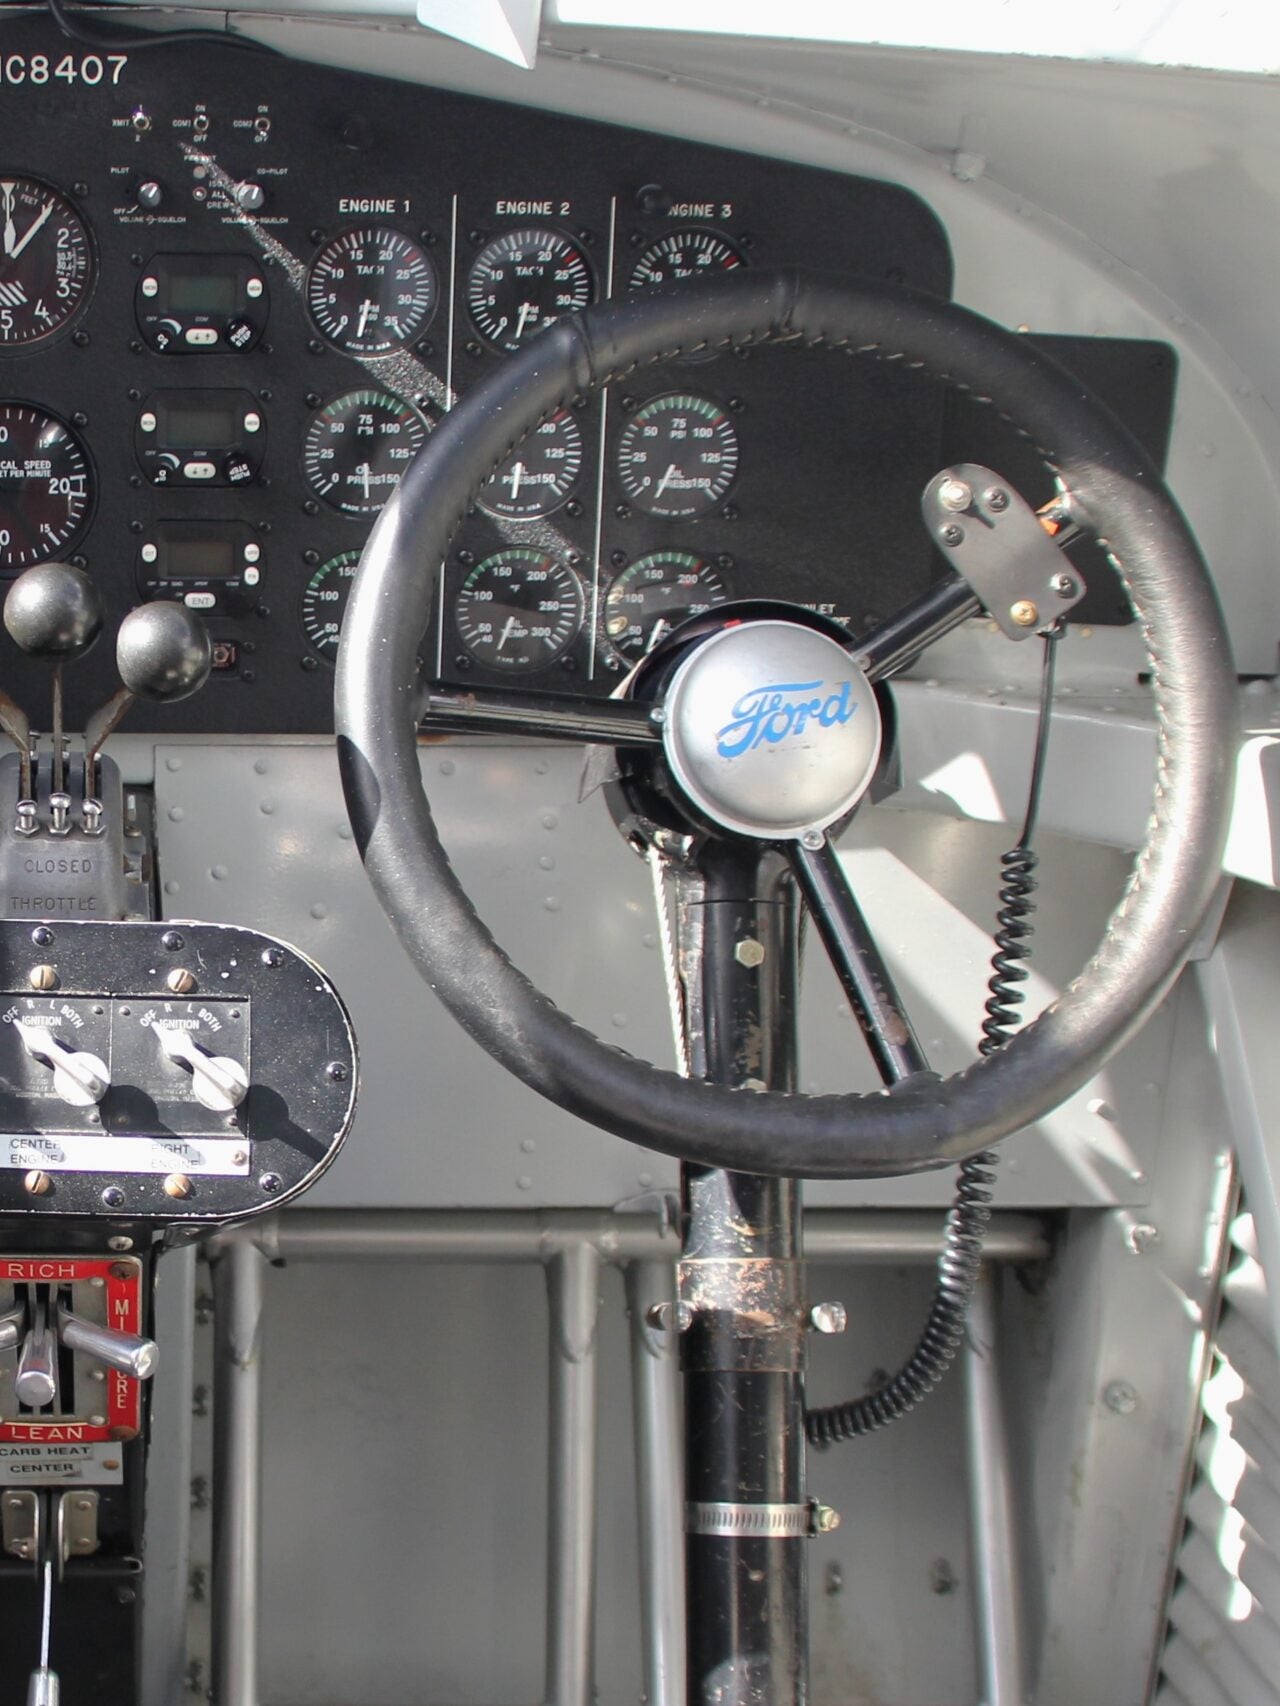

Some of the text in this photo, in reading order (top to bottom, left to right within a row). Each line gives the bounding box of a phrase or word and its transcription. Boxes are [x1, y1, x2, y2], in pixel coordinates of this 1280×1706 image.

[194, 105, 206, 113] ON
[257, 105, 269, 113] ON
[193, 134, 209, 143] OFF
[110, 167, 130, 175] PILOT
[338, 200, 410, 214] ENGINE 1
[495, 201, 570, 216] ENGINE 2
[668, 203, 733, 219] NGINE 3
[56, 227, 70, 249] 2
[56, 278, 71, 298] 3
[34, 298, 50, 319] 4
[0, 309, 14, 330] 5
[380, 423, 401, 434] 100
[670, 429, 687, 440] PSI
[692, 427, 714, 439] 100
[389, 449, 410, 460] 125
[545, 448, 566, 460] 125
[699, 453, 721, 463] 125
[23, 459, 52, 471] SPEED
[9, 469, 25, 478] PER
[26, 469, 52, 478] MINUTE
[48, 477, 70, 495] 20
[492, 566, 513, 578] 150
[527, 570, 548, 582] 200
[643, 569, 664, 580] 150
[677, 573, 699, 584] 200
[192, 597, 210, 605] ENT
[319, 590, 339, 602] 100
[473, 590, 494, 602] 100
[624, 593, 645, 604] 100
[539, 600, 560, 612] 250
[530, 627, 552, 638] 300
[716, 680, 860, 759] Ford
[23, 859, 93, 874] CLOSED
[10, 897, 98, 911] THROTTLE
[2, 999, 85, 1030] OFF R L BOTH
[139, 1002, 223, 1033] OFF R L BOTH
[21, 1015, 62, 1027] IGNITION
[159, 1018, 201, 1030] IGNITION
[7, 1263, 76, 1278] RICH
[11, 1426, 84, 1440] LEAN
[47, 1445, 92, 1456] HEAT
[9, 1463, 74, 1473] CENTER
